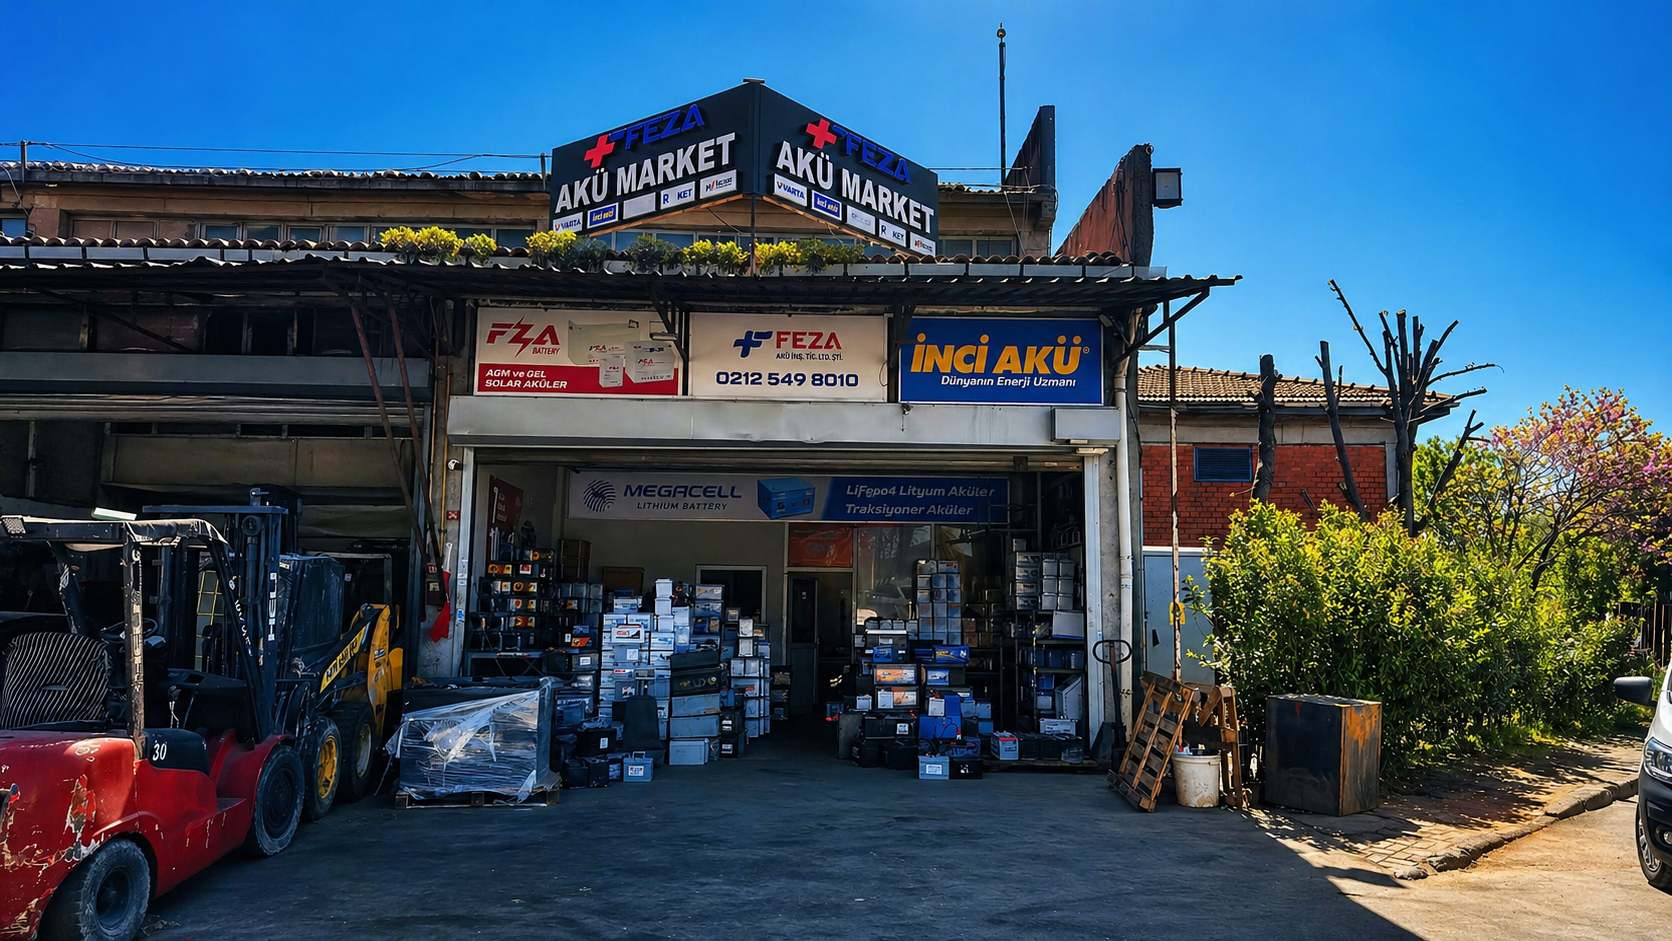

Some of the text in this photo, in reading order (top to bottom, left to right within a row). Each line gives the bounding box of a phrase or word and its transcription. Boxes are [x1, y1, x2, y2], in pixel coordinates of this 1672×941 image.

[625, 104, 704, 149] FEZA
[846, 132, 911, 184] FEZA
[555, 132, 735, 213] AKÜ MARKET
[776, 140, 934, 233] AKÜ MARKET
[783, 183, 805, 199] VARTA
[776, 331, 842, 349] FEZA
[532, 347, 560, 355] BATTERY
[776, 352, 790, 360] AKÜ
[818, 353, 831, 361] LTD.
[910, 333, 1082, 375] İNCİ AKÜ
[485, 369, 510, 378] AGM
[526, 370, 546, 378] GEL
[716, 371, 859, 387] 0212 549 8010
[485, 378, 568, 389] SOLAR AKÜLER
[941, 375, 1076, 388] Dünyanın Enerji Uzmanı
[623, 485, 742, 498] MEGACELL
[899, 485, 945, 498] Lityum
[947, 486, 994, 497] Aküler
[637, 502, 728, 510] LITHIUM BATTERY
[846, 503, 973, 517] Traksiyoner Aküler
[152, 740, 167, 761] 30
